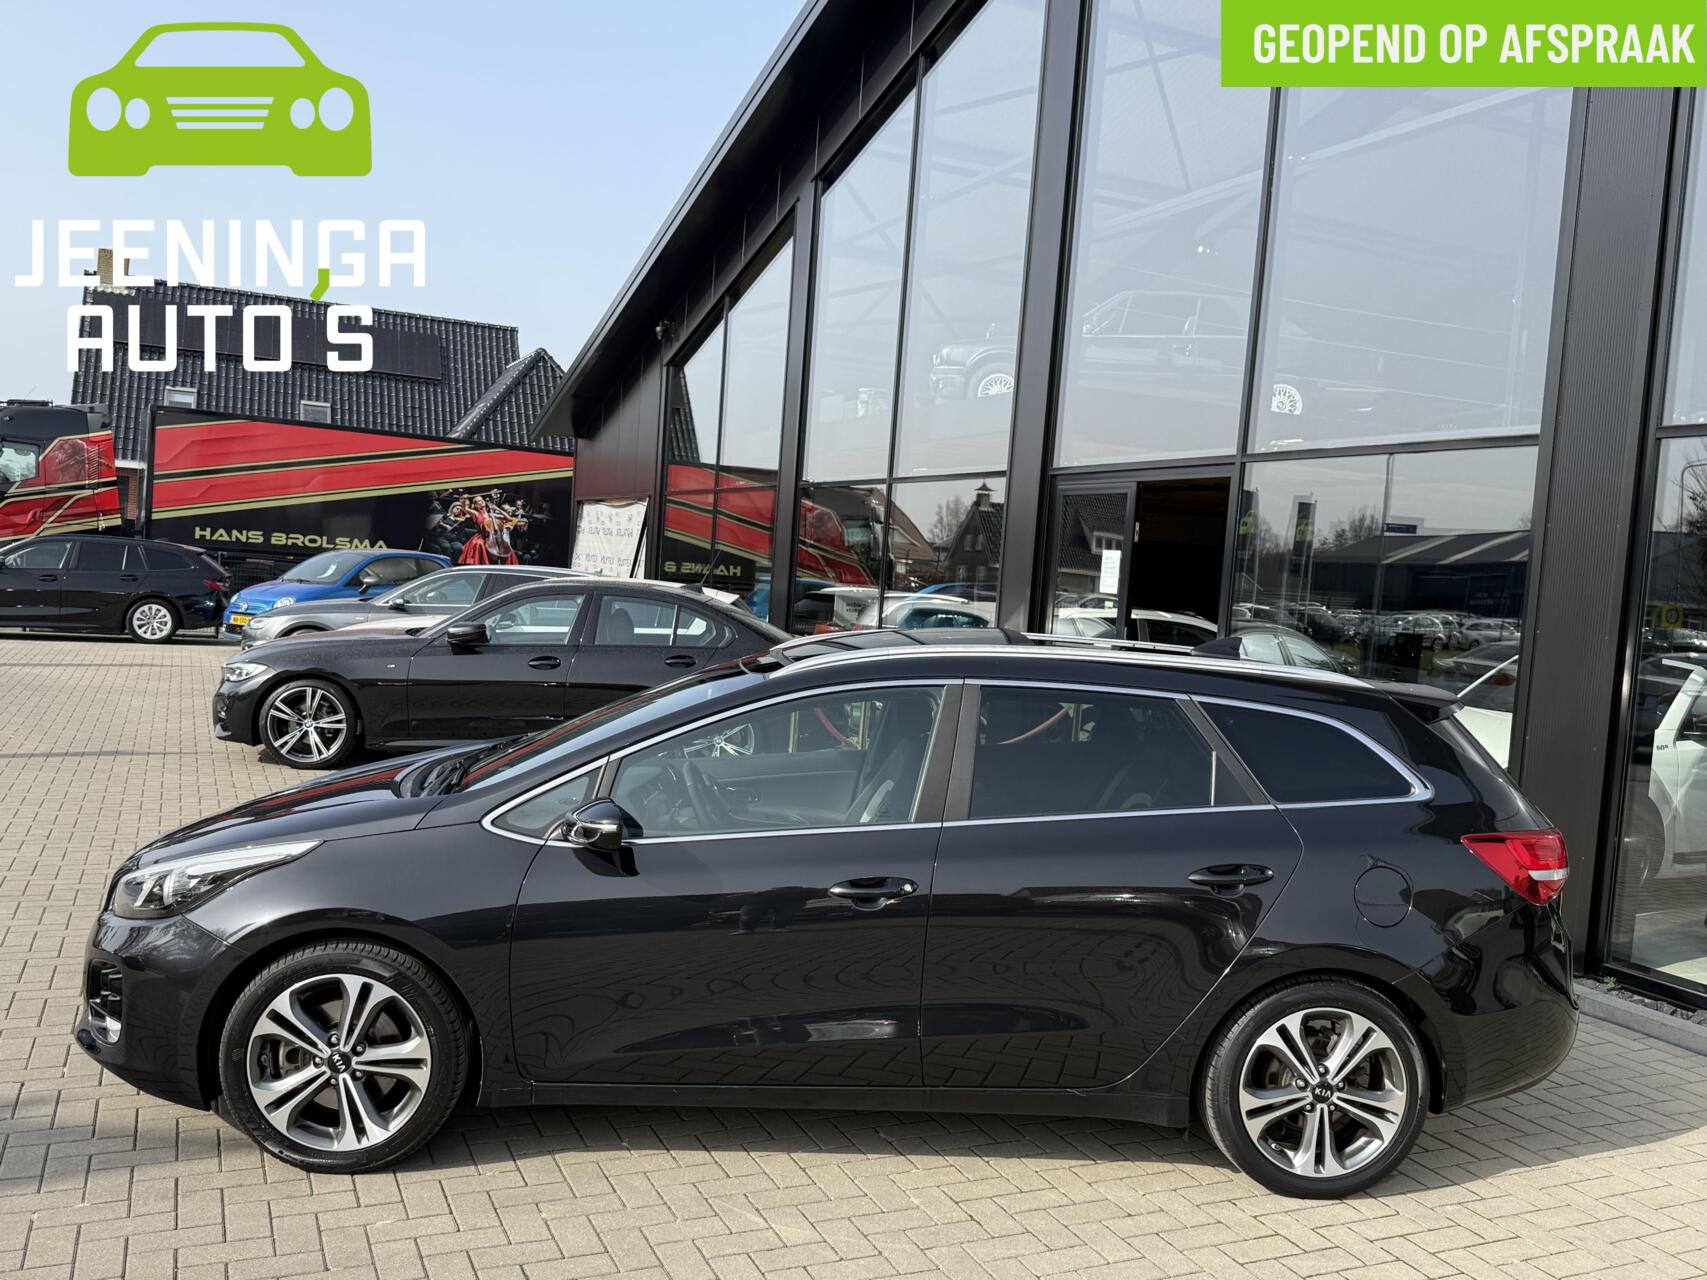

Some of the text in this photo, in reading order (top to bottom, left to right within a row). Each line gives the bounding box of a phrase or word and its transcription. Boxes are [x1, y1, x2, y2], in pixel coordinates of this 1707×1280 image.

[194, 526, 388, 550] HANS BROLSMA
[332, 1053, 346, 1073] KIA
[1314, 1087, 1331, 1099] KIA
